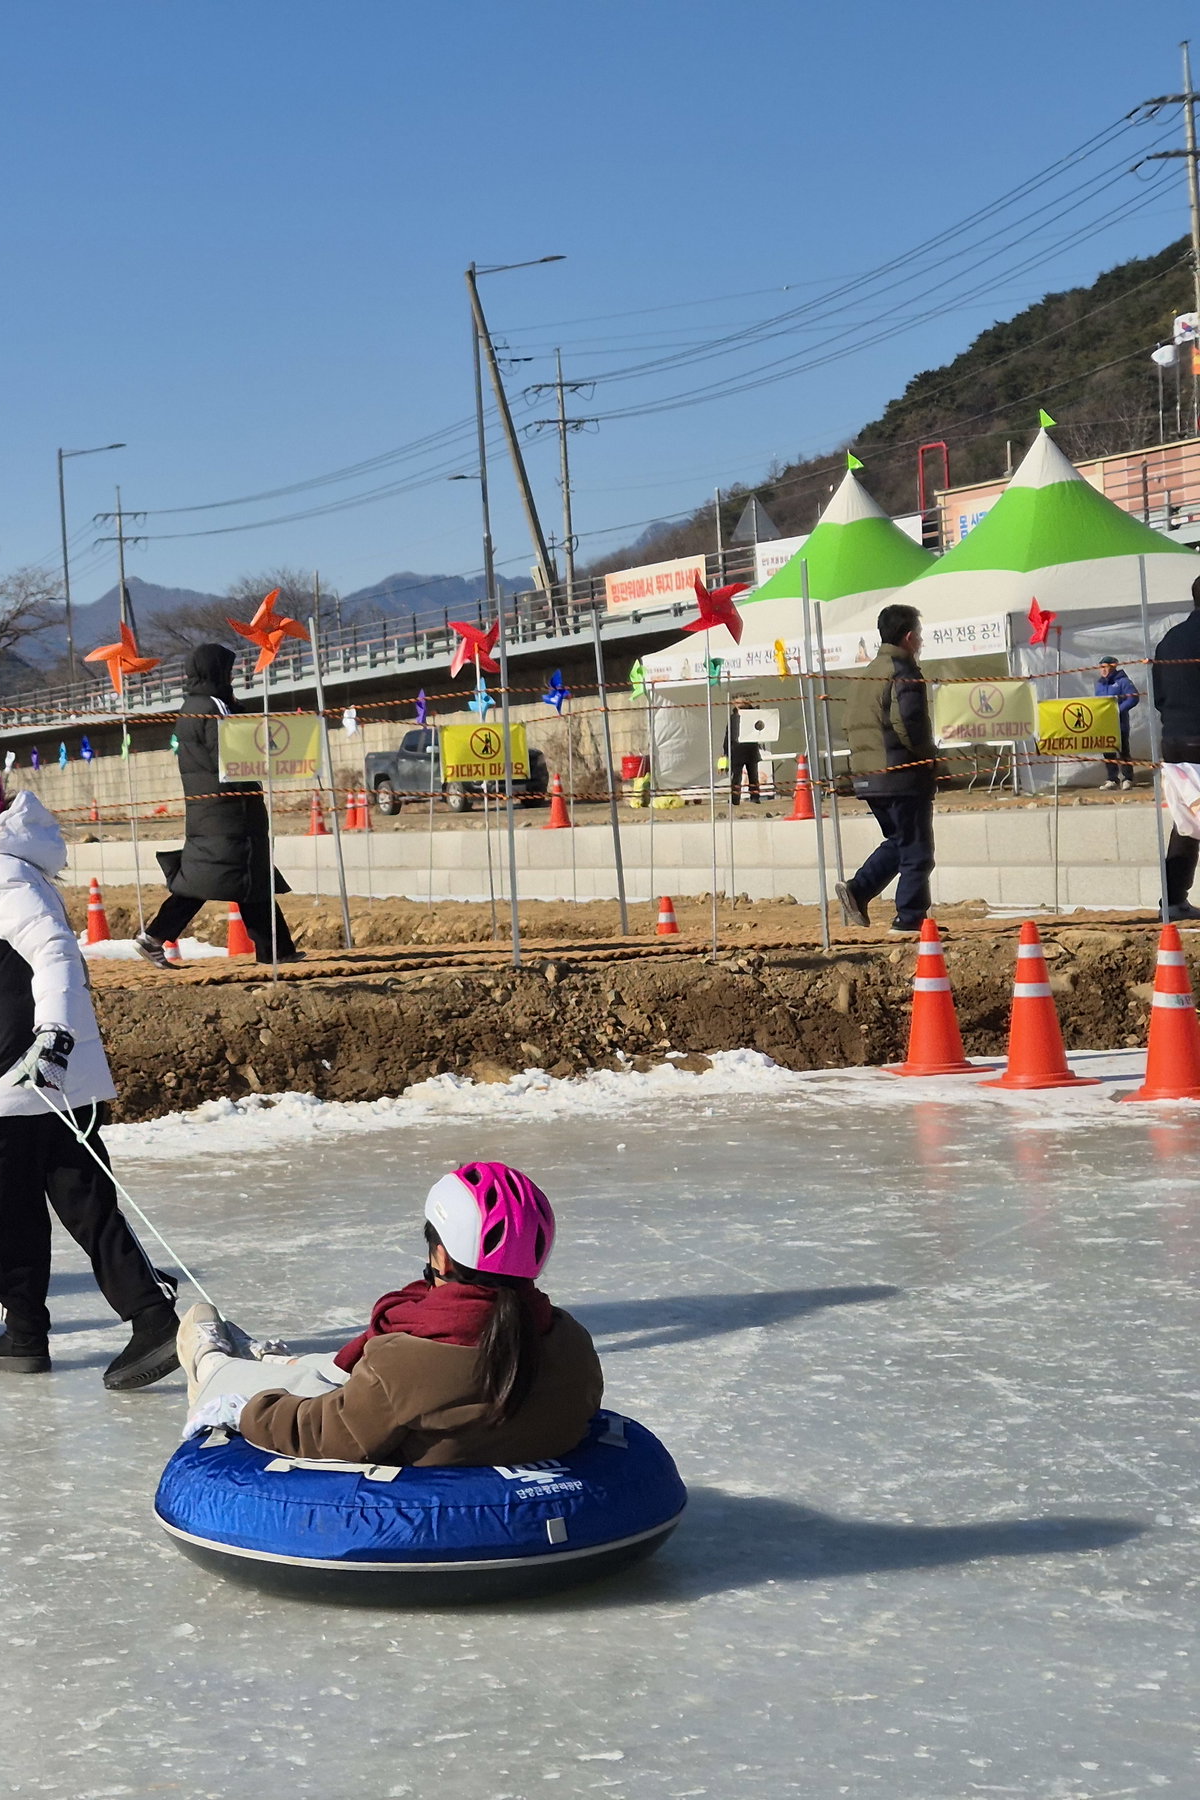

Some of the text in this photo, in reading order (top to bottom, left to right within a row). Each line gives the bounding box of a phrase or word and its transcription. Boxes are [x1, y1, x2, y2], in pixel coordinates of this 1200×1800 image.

[933, 622, 1001, 645] 취식 전용 공간
[1039, 735, 1117, 751] 기대지 마세요
[446, 763, 486, 778] 기대지
